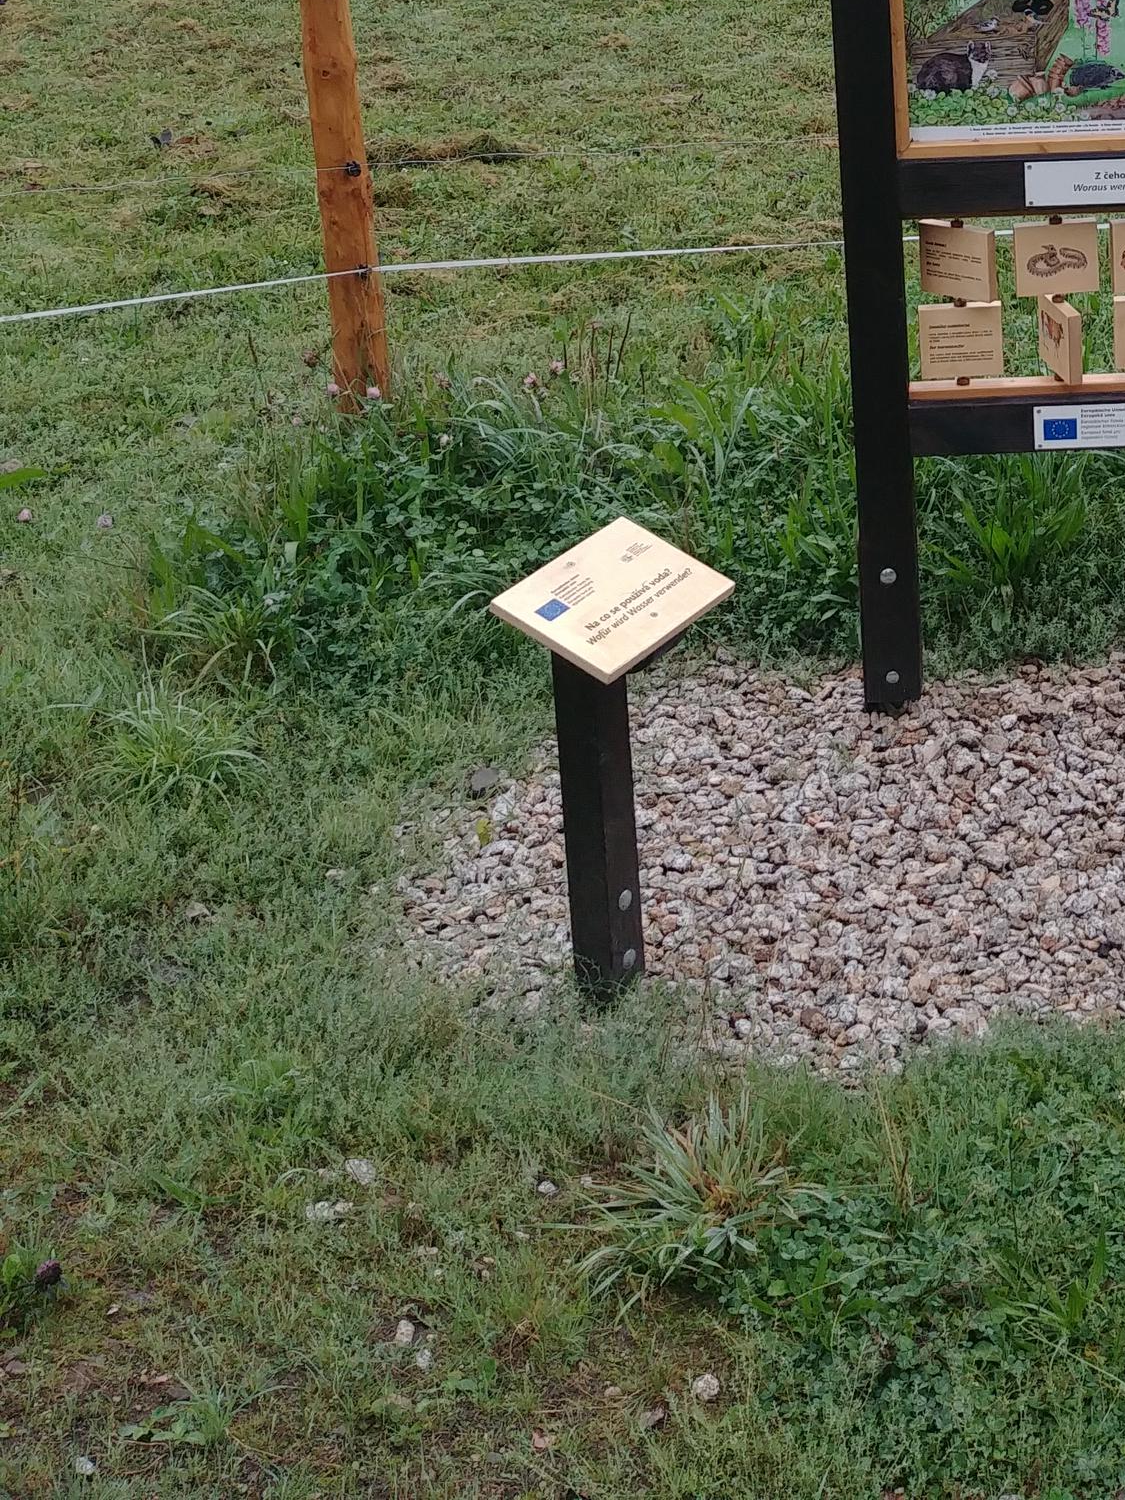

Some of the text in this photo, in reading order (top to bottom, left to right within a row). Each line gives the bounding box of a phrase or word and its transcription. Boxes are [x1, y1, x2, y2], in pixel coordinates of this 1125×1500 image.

[1073, 183, 1108, 192] Woraus
[1094, 171, 1101, 180] Z
[1103, 171, 1125, 180] čeho
[585, 621, 601, 631] Na
[599, 612, 612, 622] co
[610, 606, 621, 615] se
[649, 568, 673, 587] voda?
[611, 613, 630, 629] wird
[626, 596, 655, 616] Wasser
[654, 567, 693, 598] verwendet?
